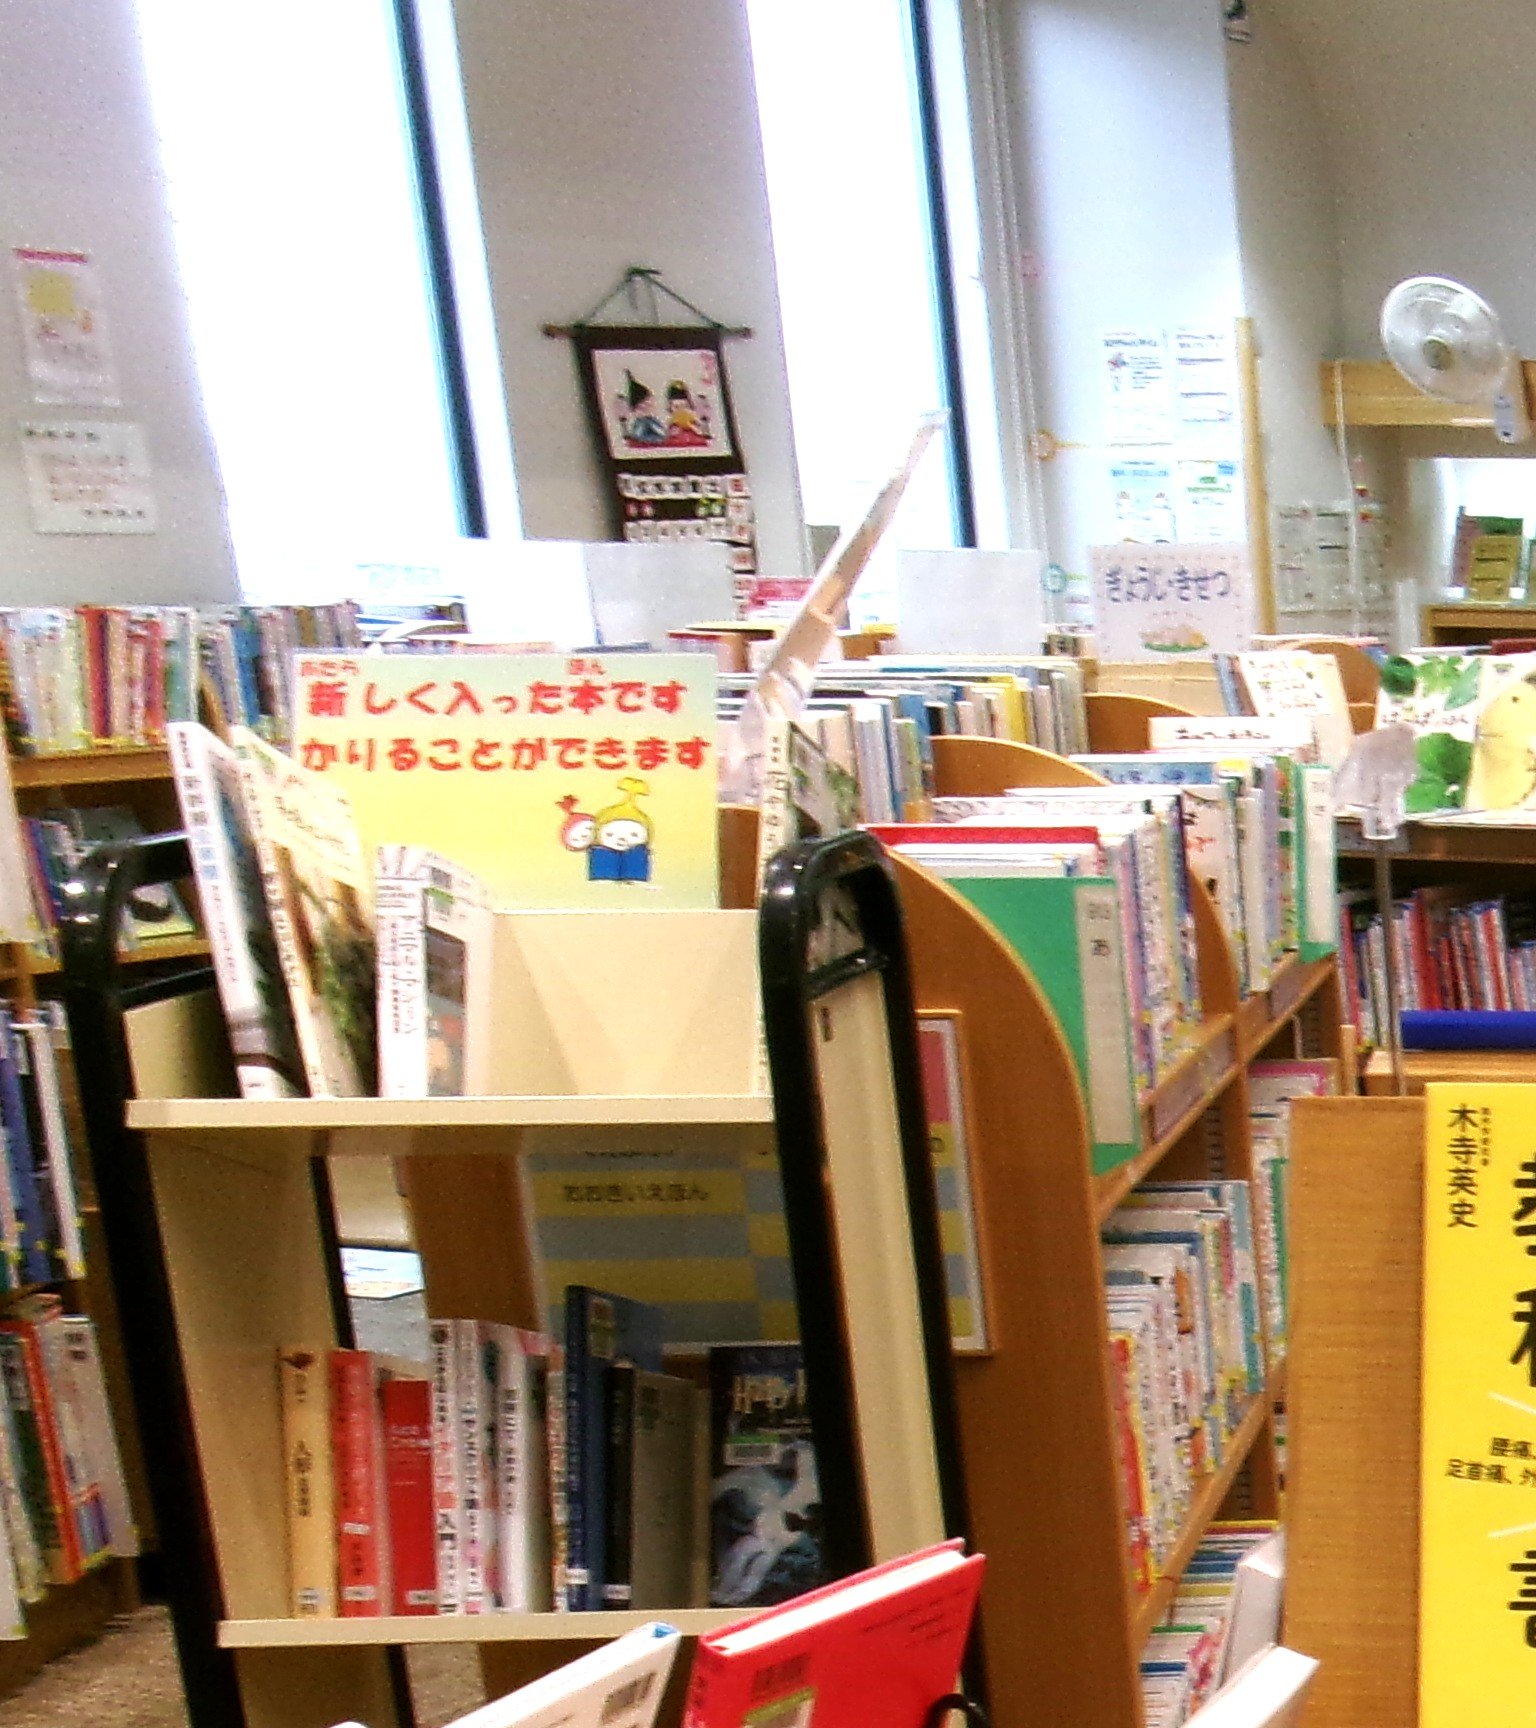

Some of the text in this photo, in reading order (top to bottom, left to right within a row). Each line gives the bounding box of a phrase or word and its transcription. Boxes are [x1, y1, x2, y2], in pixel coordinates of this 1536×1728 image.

[307, 681, 689, 716] 新しく入った本です
[300, 737, 714, 773] かりることができます
[1447, 1103, 1479, 1229] 木寺英史
